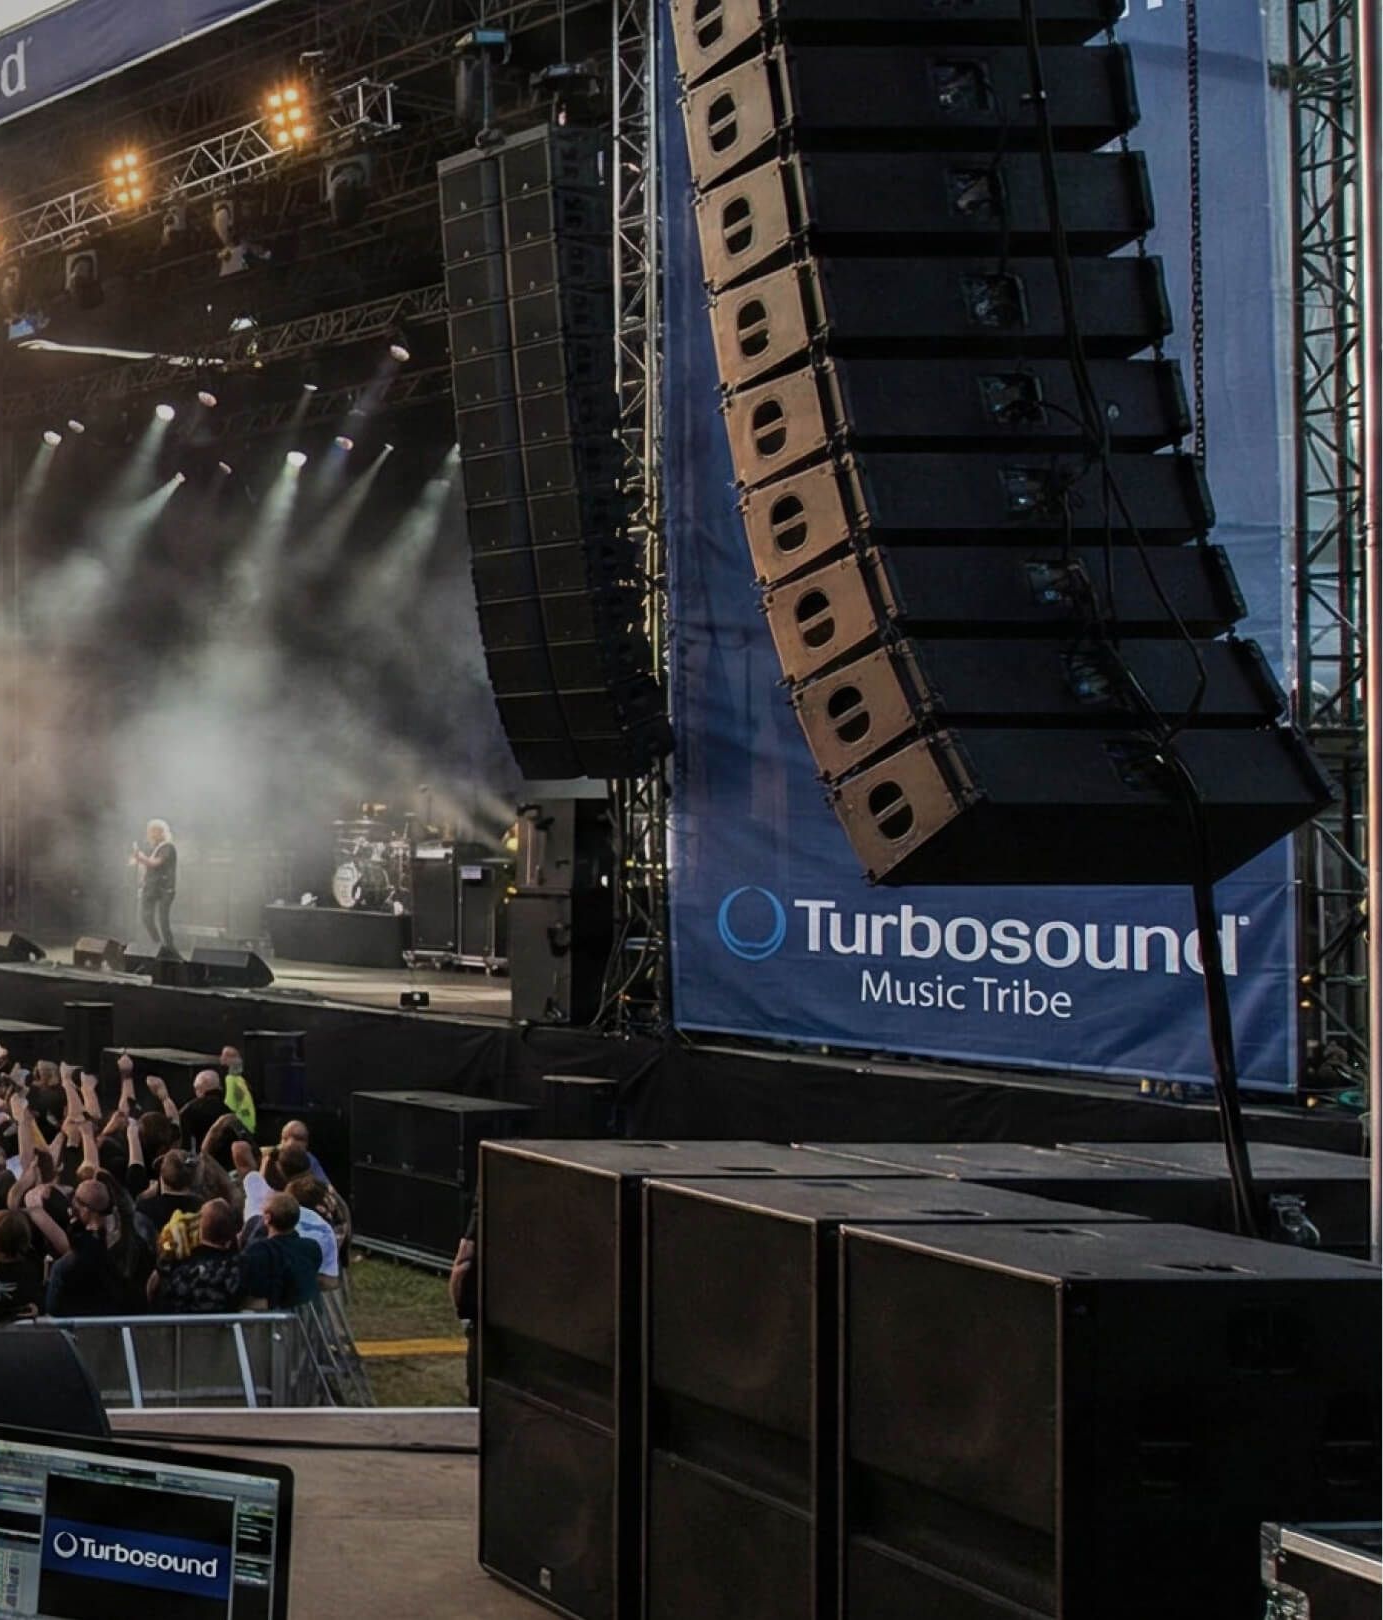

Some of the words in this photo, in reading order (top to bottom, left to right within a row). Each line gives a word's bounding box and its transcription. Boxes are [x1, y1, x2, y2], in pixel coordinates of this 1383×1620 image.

[861, 970, 966, 1011] Music
[973, 977, 1073, 1018] Tribe
[80, 1537, 218, 1577] Turbosound
